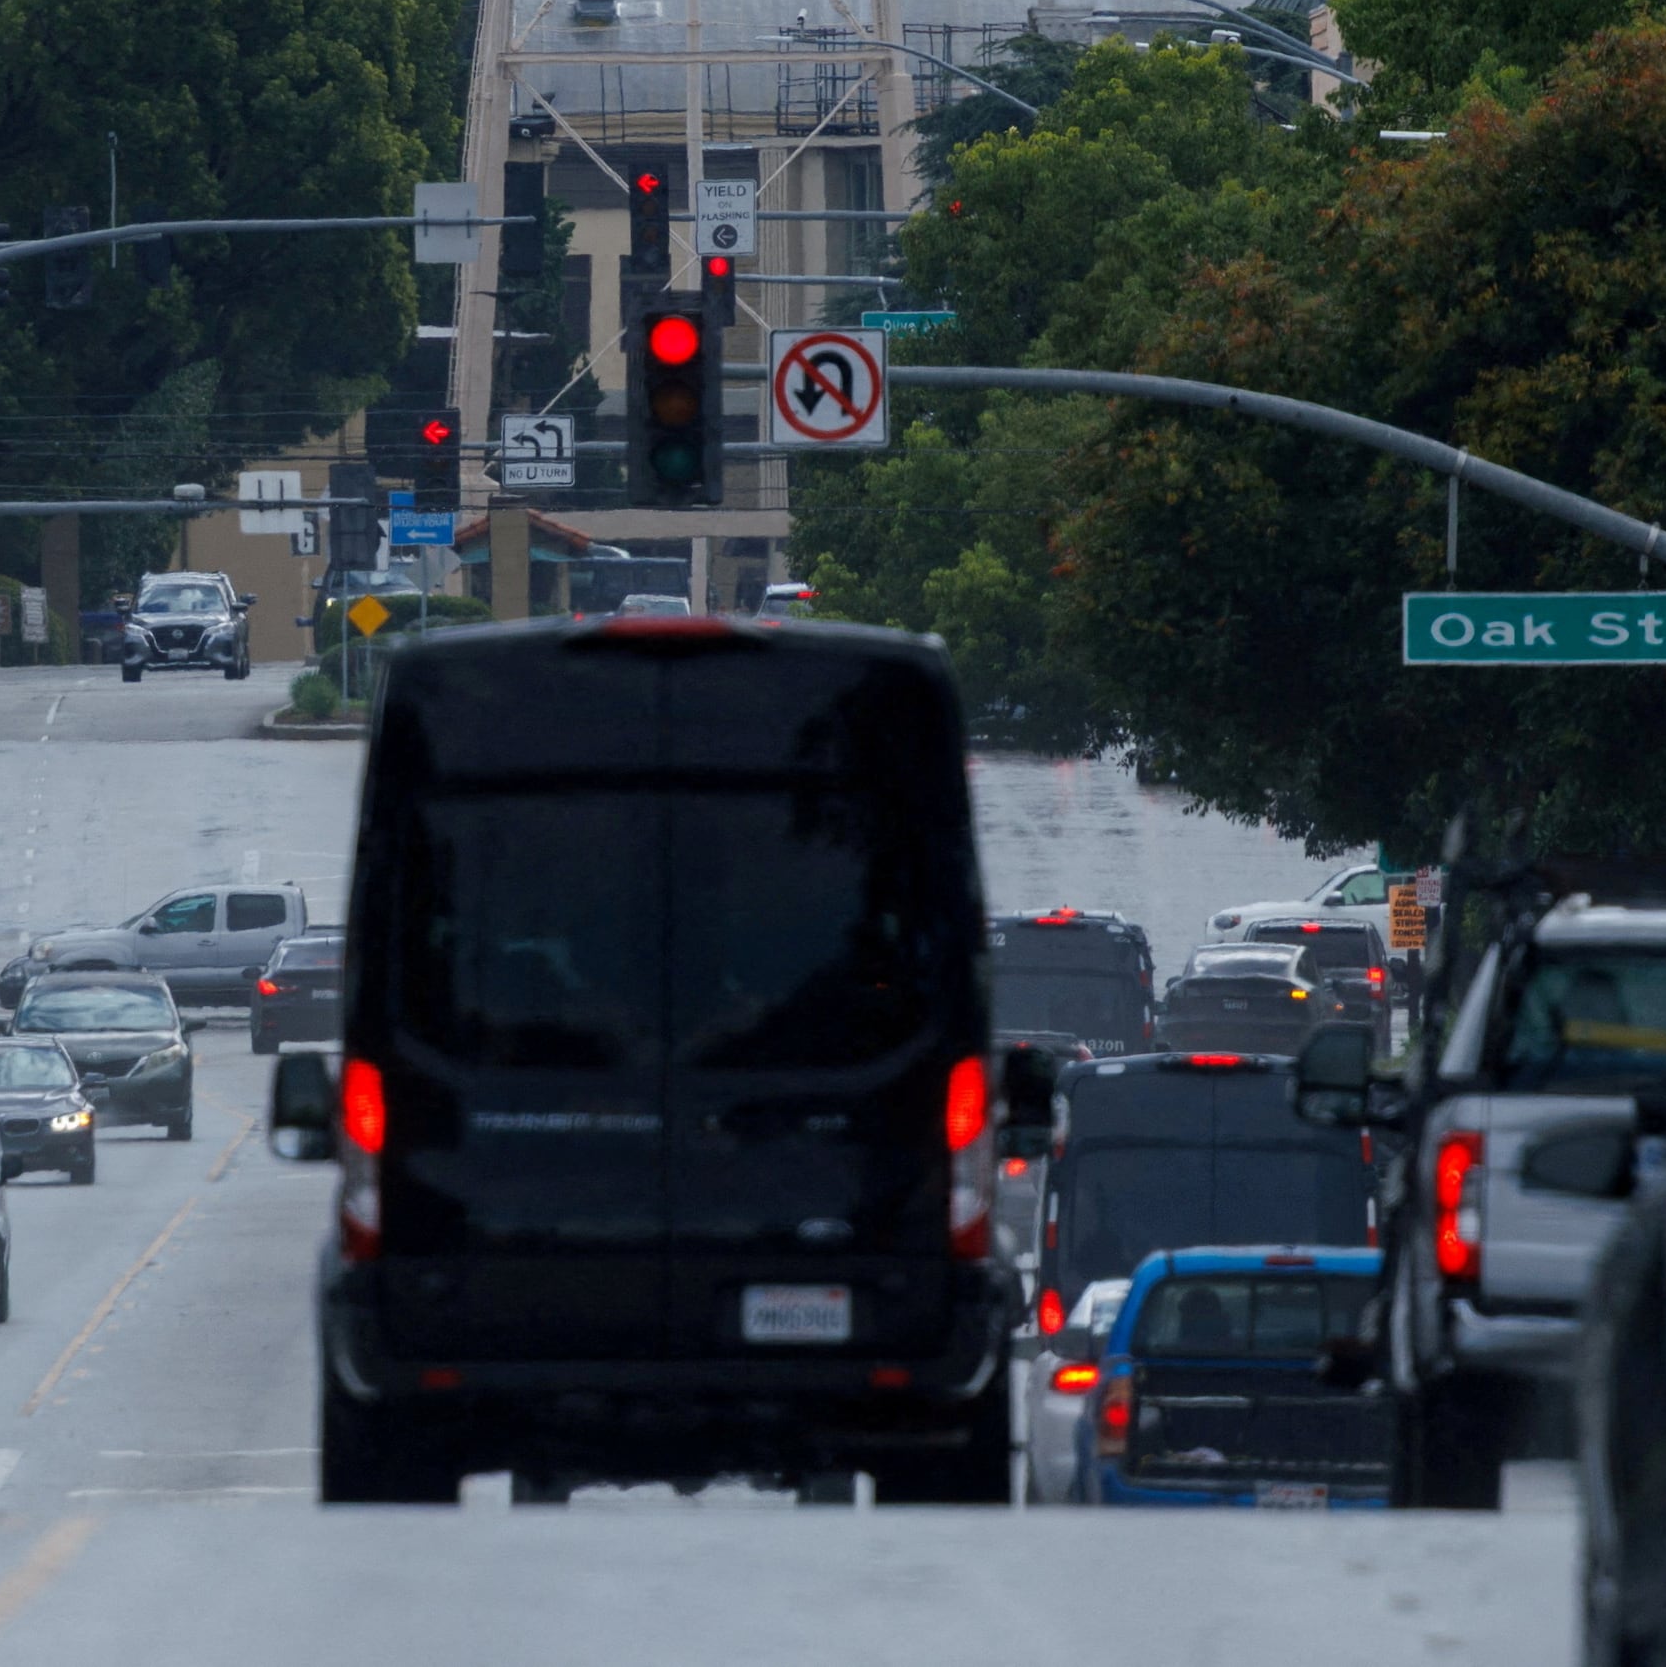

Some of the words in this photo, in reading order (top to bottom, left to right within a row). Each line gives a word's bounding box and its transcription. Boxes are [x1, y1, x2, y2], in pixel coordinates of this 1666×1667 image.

[704, 185, 747, 197] YIELD
[718, 201, 732, 209] ON
[701, 211, 750, 221] FLASHING
[509, 470, 523, 479] NO
[526, 466, 538, 480] U
[540, 468, 568, 478] TURN
[1430, 612, 1557, 647] Oak
[1589, 611, 1664, 646] St
